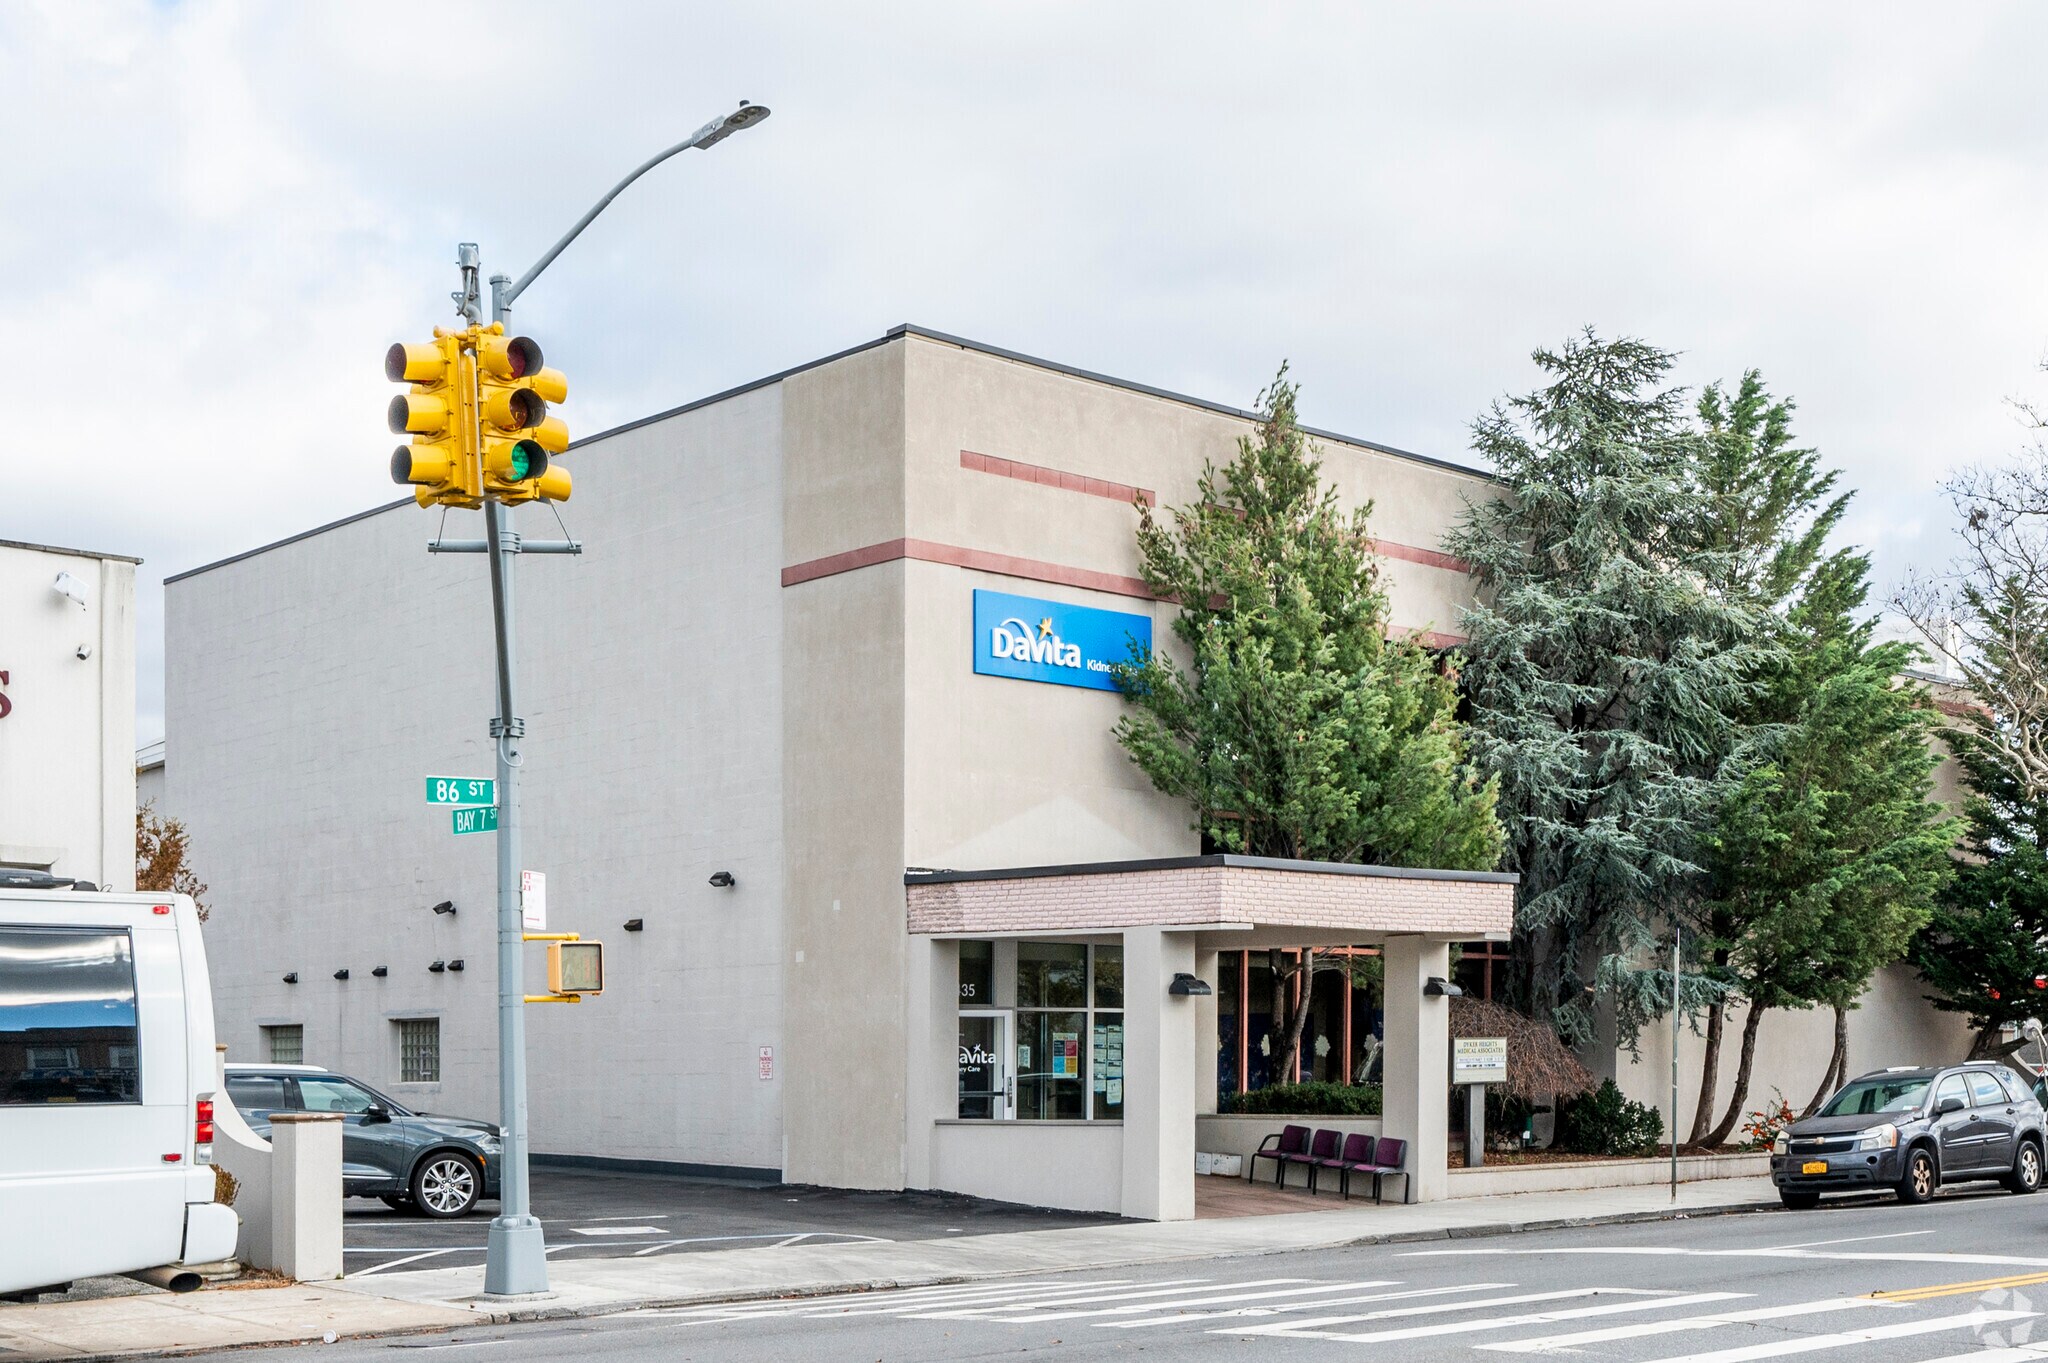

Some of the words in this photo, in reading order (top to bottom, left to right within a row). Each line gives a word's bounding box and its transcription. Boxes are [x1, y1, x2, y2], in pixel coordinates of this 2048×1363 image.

[436, 779, 460, 802] 86
[468, 781, 486, 797] ST
[457, 810, 476, 832] BAY
[479, 809, 486, 830] 7
[490, 808, 498, 820] ST
[960, 983, 976, 997] 35
[959, 1045, 997, 1064] aVita
